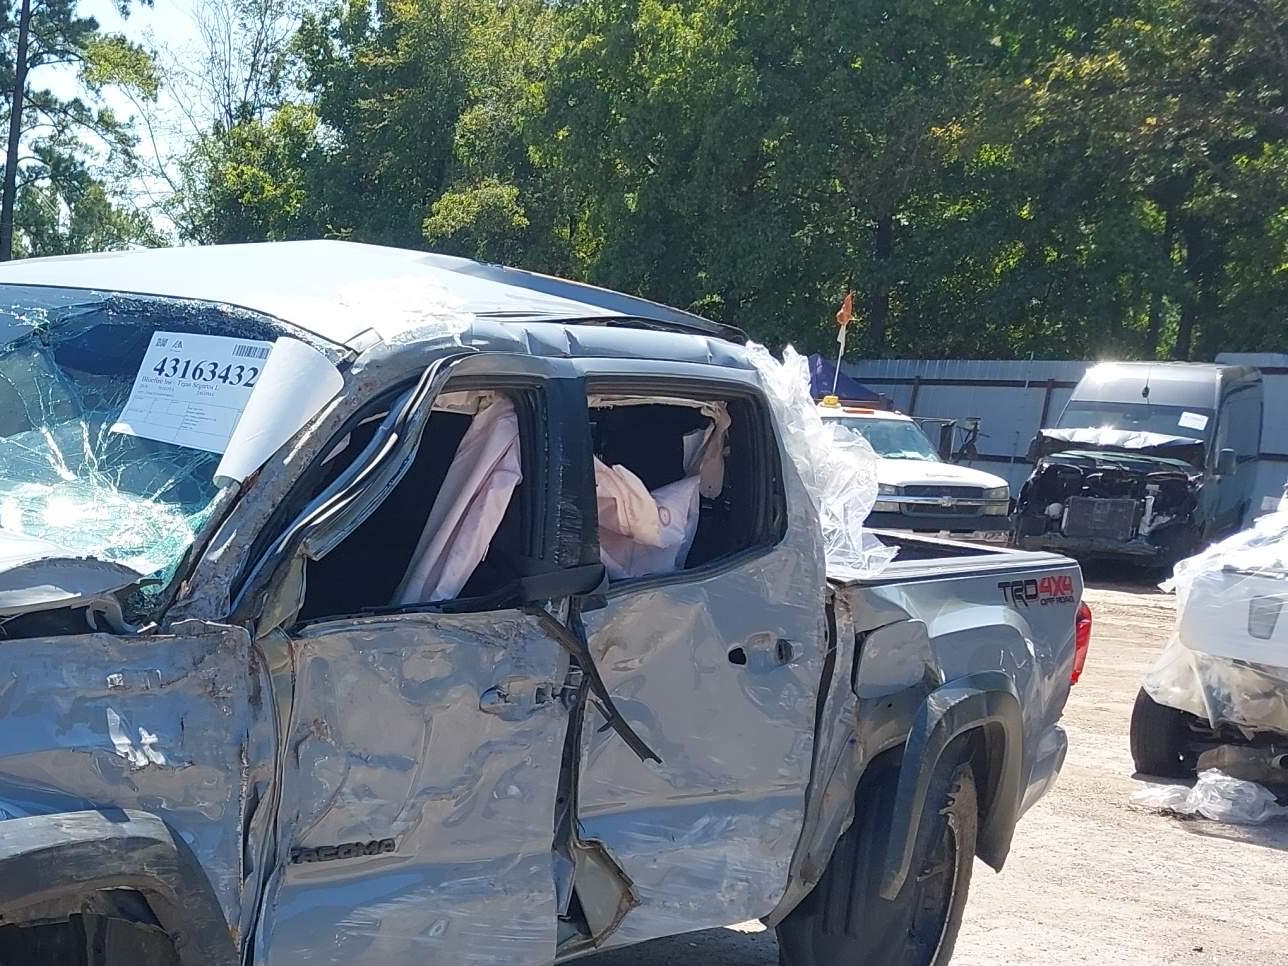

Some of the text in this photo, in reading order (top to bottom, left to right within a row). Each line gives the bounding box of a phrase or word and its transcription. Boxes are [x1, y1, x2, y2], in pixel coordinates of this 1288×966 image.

[153, 357, 259, 388] 43163432
[998, 575, 1073, 607] TRD 4X4
